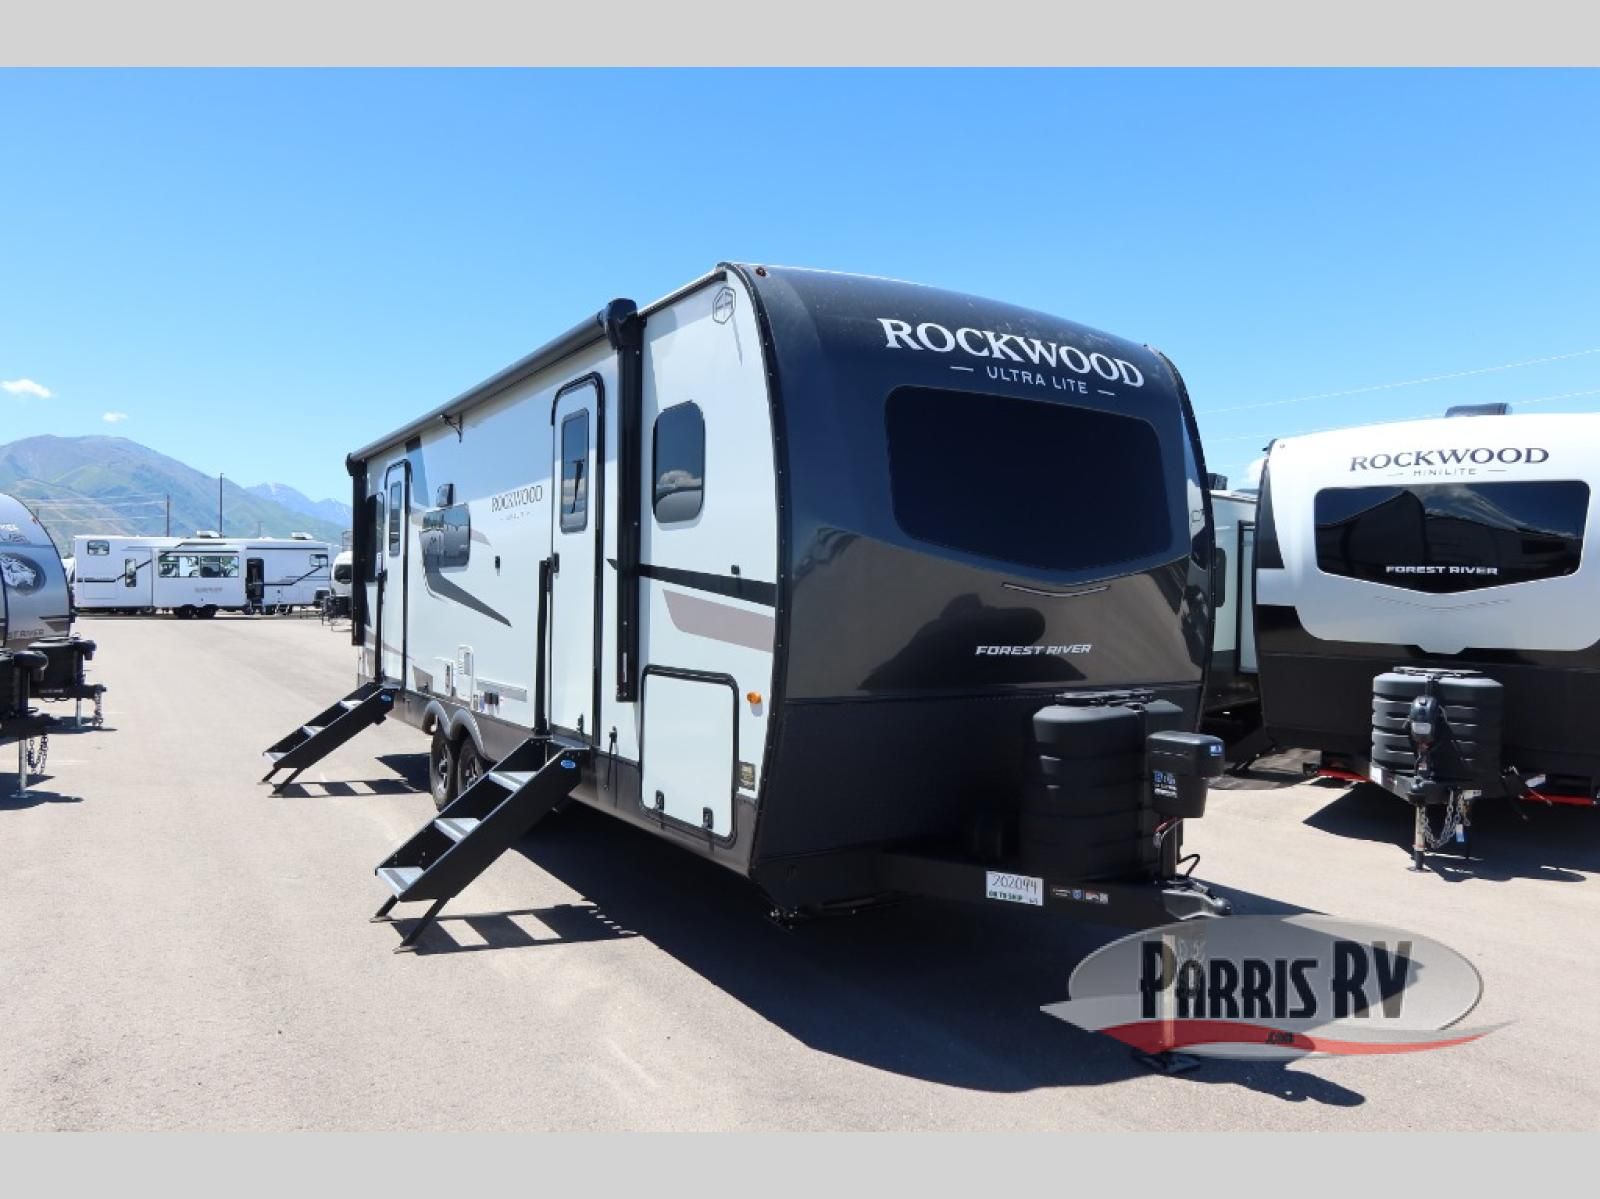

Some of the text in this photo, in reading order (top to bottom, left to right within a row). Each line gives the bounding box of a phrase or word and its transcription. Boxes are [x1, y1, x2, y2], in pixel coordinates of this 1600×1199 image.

[876, 317, 1145, 388] ROCKWOOD
[986, 365, 1088, 394] ULTRA LITE
[1350, 447, 1549, 472] ROCKWOOD
[491, 485, 543, 513] ROCKWOOD
[1385, 565, 1498, 575] FOREST RIVER
[975, 643, 1092, 655] FOREST RIVER
